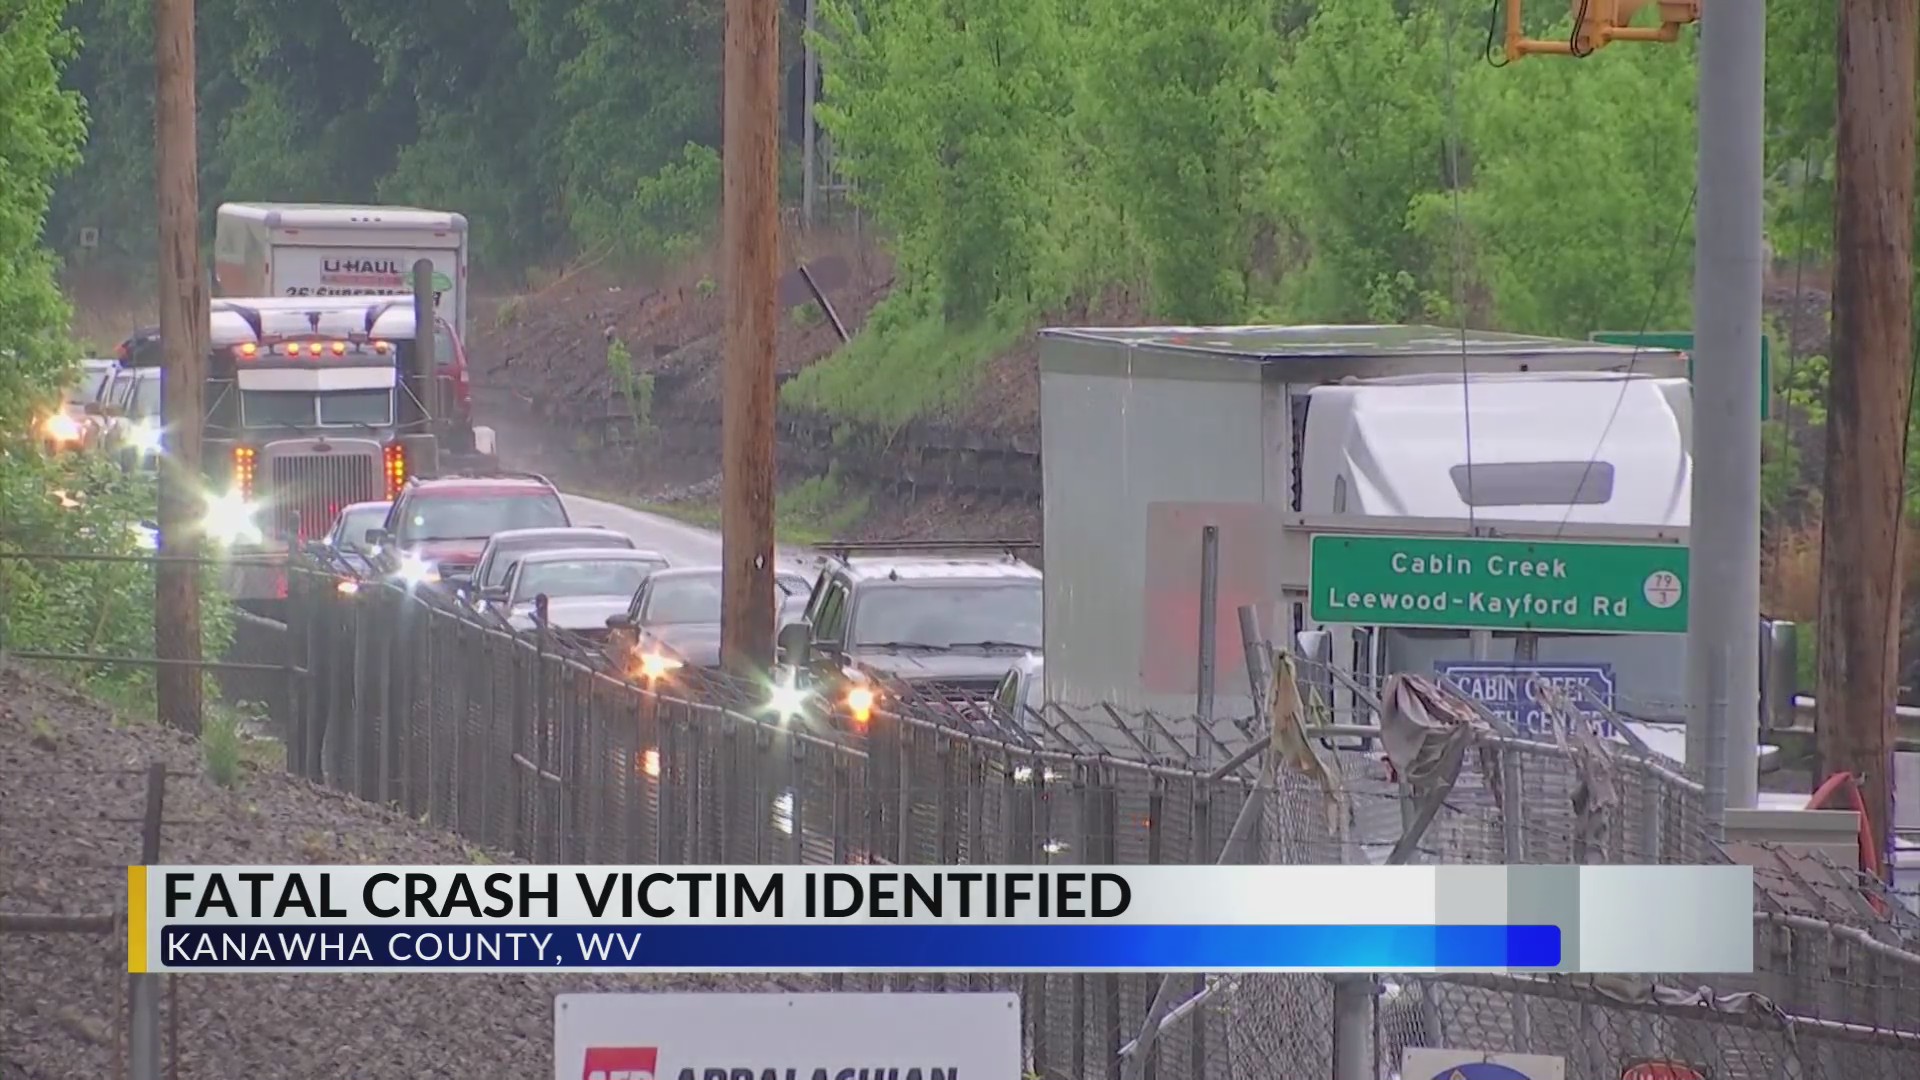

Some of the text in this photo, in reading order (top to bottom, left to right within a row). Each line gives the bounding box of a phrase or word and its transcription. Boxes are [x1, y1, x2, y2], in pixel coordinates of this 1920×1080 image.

[1391, 552, 1569, 579] Cabin Creek
[1655, 574, 1673, 588] 79
[1328, 587, 1629, 619] Leewood-Kayford Rd
[1458, 676, 1518, 701] CABIN
